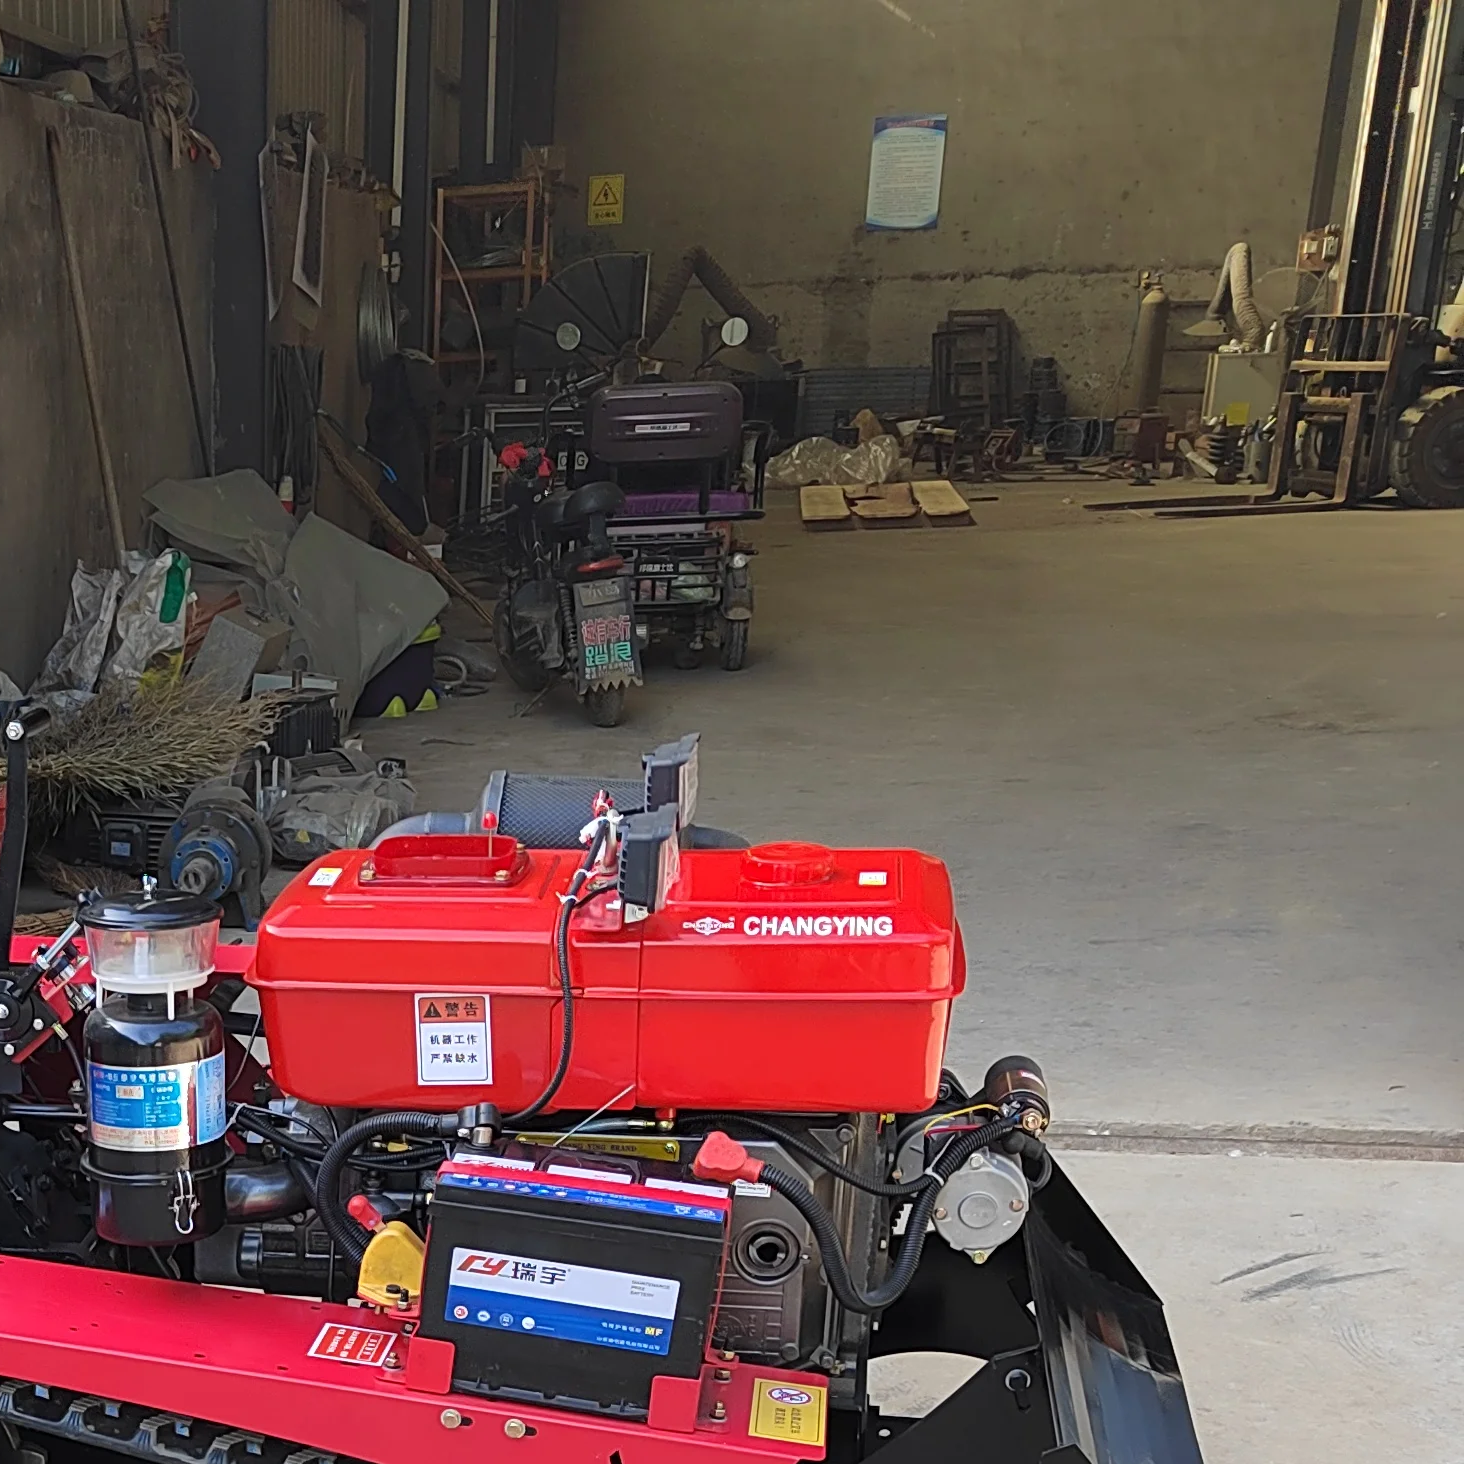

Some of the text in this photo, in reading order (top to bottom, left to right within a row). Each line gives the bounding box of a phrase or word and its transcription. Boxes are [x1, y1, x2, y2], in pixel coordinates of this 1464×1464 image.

[743, 916, 893, 937] CHANGYING
[444, 1001, 479, 1018] 警告
[429, 1034, 478, 1045] 机器工作
[430, 1052, 478, 1064] 严禁缺水
[610, 1144, 637, 1152] BRAND
[644, 1326, 664, 1337] MF
